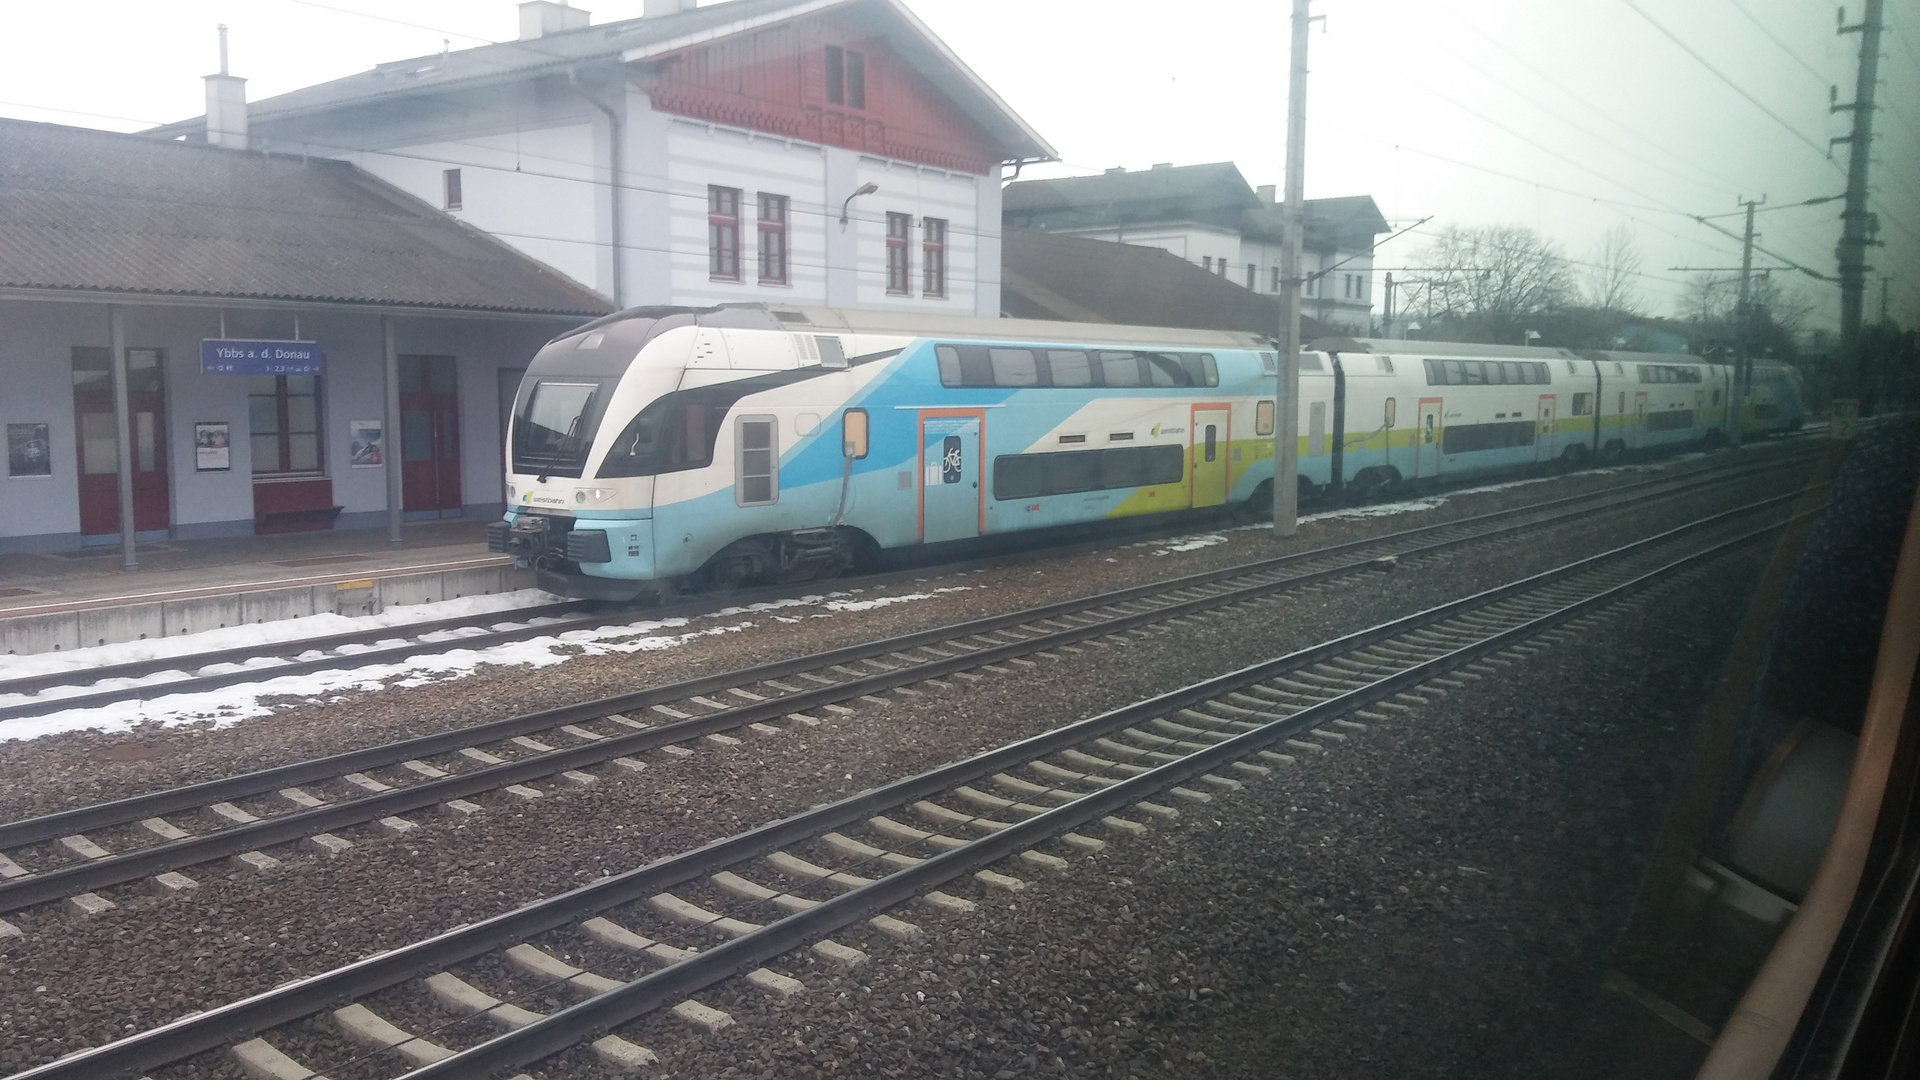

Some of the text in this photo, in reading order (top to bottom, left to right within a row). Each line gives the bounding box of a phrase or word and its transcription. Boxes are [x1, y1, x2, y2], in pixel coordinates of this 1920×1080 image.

[216, 348, 310, 360] Ybbs a. d. Donau
